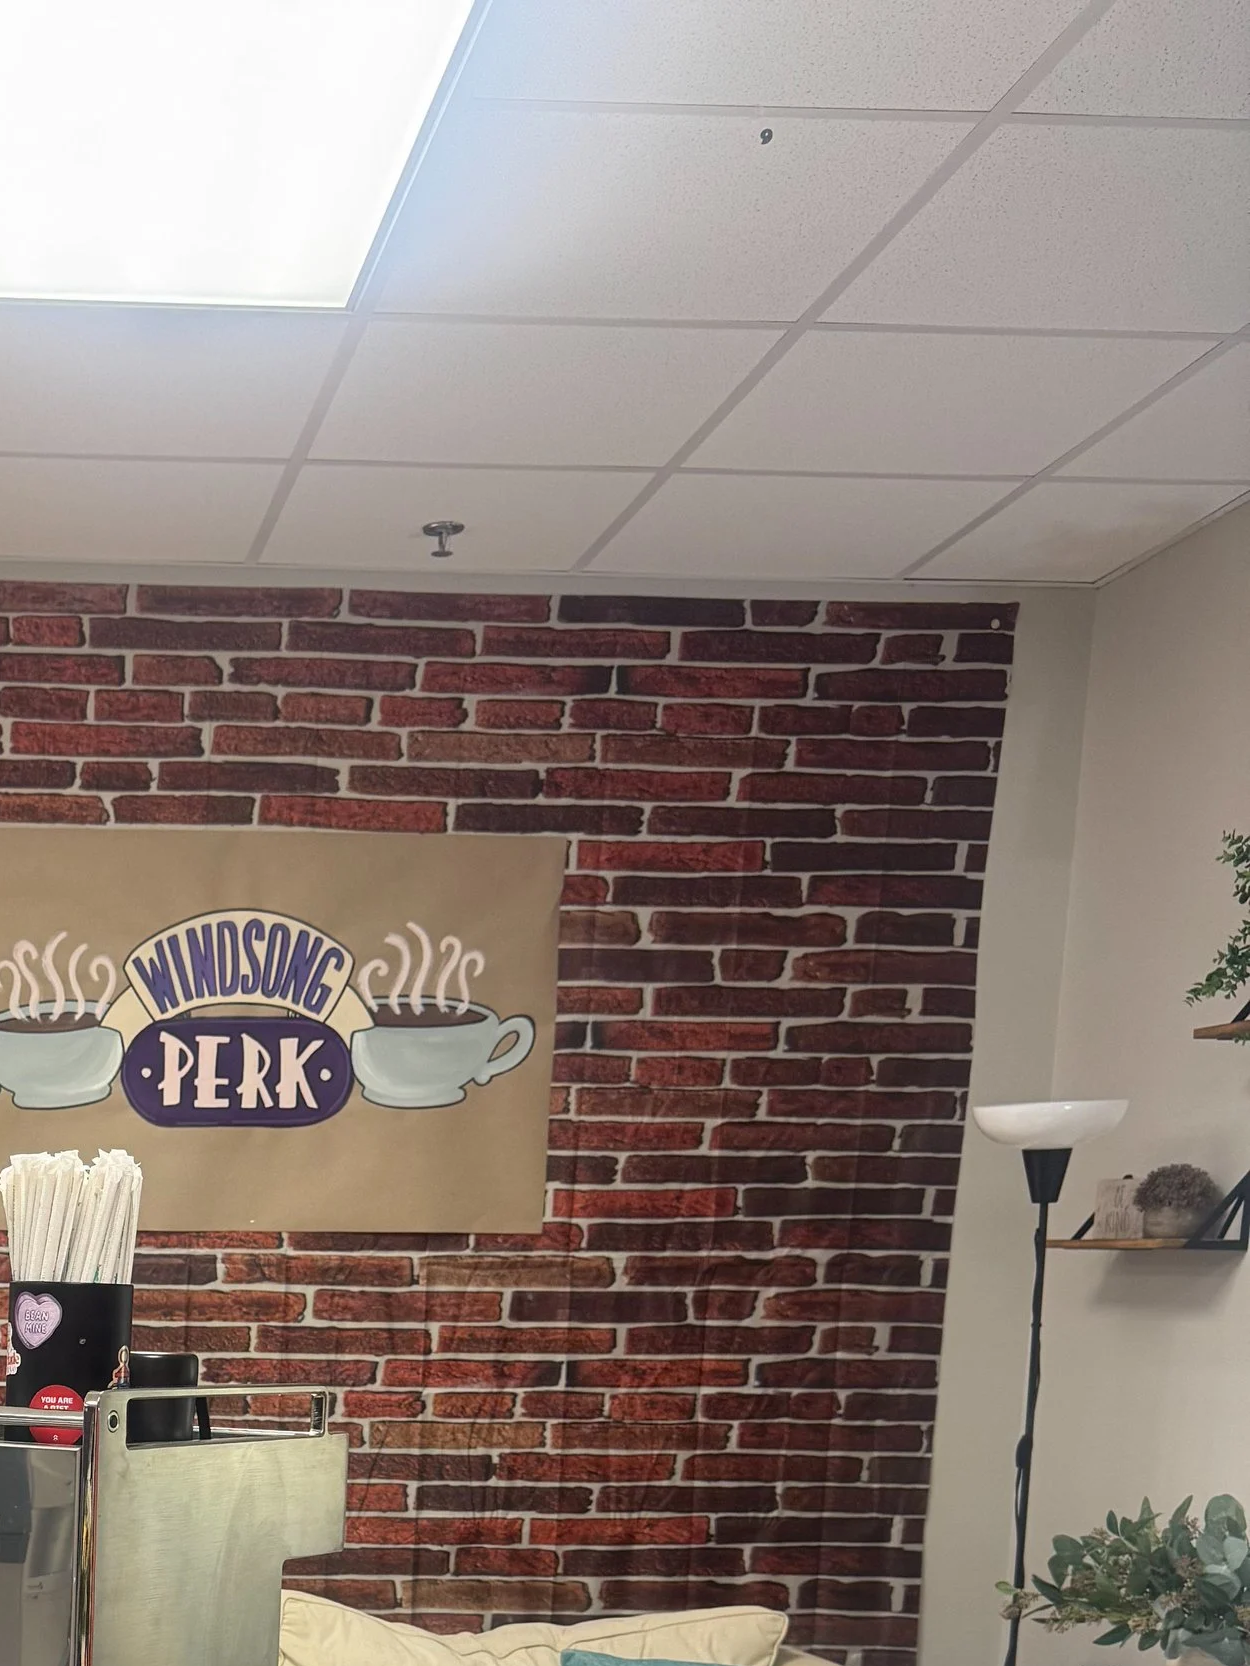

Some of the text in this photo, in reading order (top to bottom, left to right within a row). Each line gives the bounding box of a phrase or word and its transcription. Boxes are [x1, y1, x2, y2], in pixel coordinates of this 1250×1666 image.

[132, 918, 346, 1016] WINDSONG
[158, 1031, 326, 1110] PERK
[24, 1310, 49, 1321] BEAN
[24, 1322, 48, 1334] MINE
[41, 1396, 73, 1405] YOU ARE
